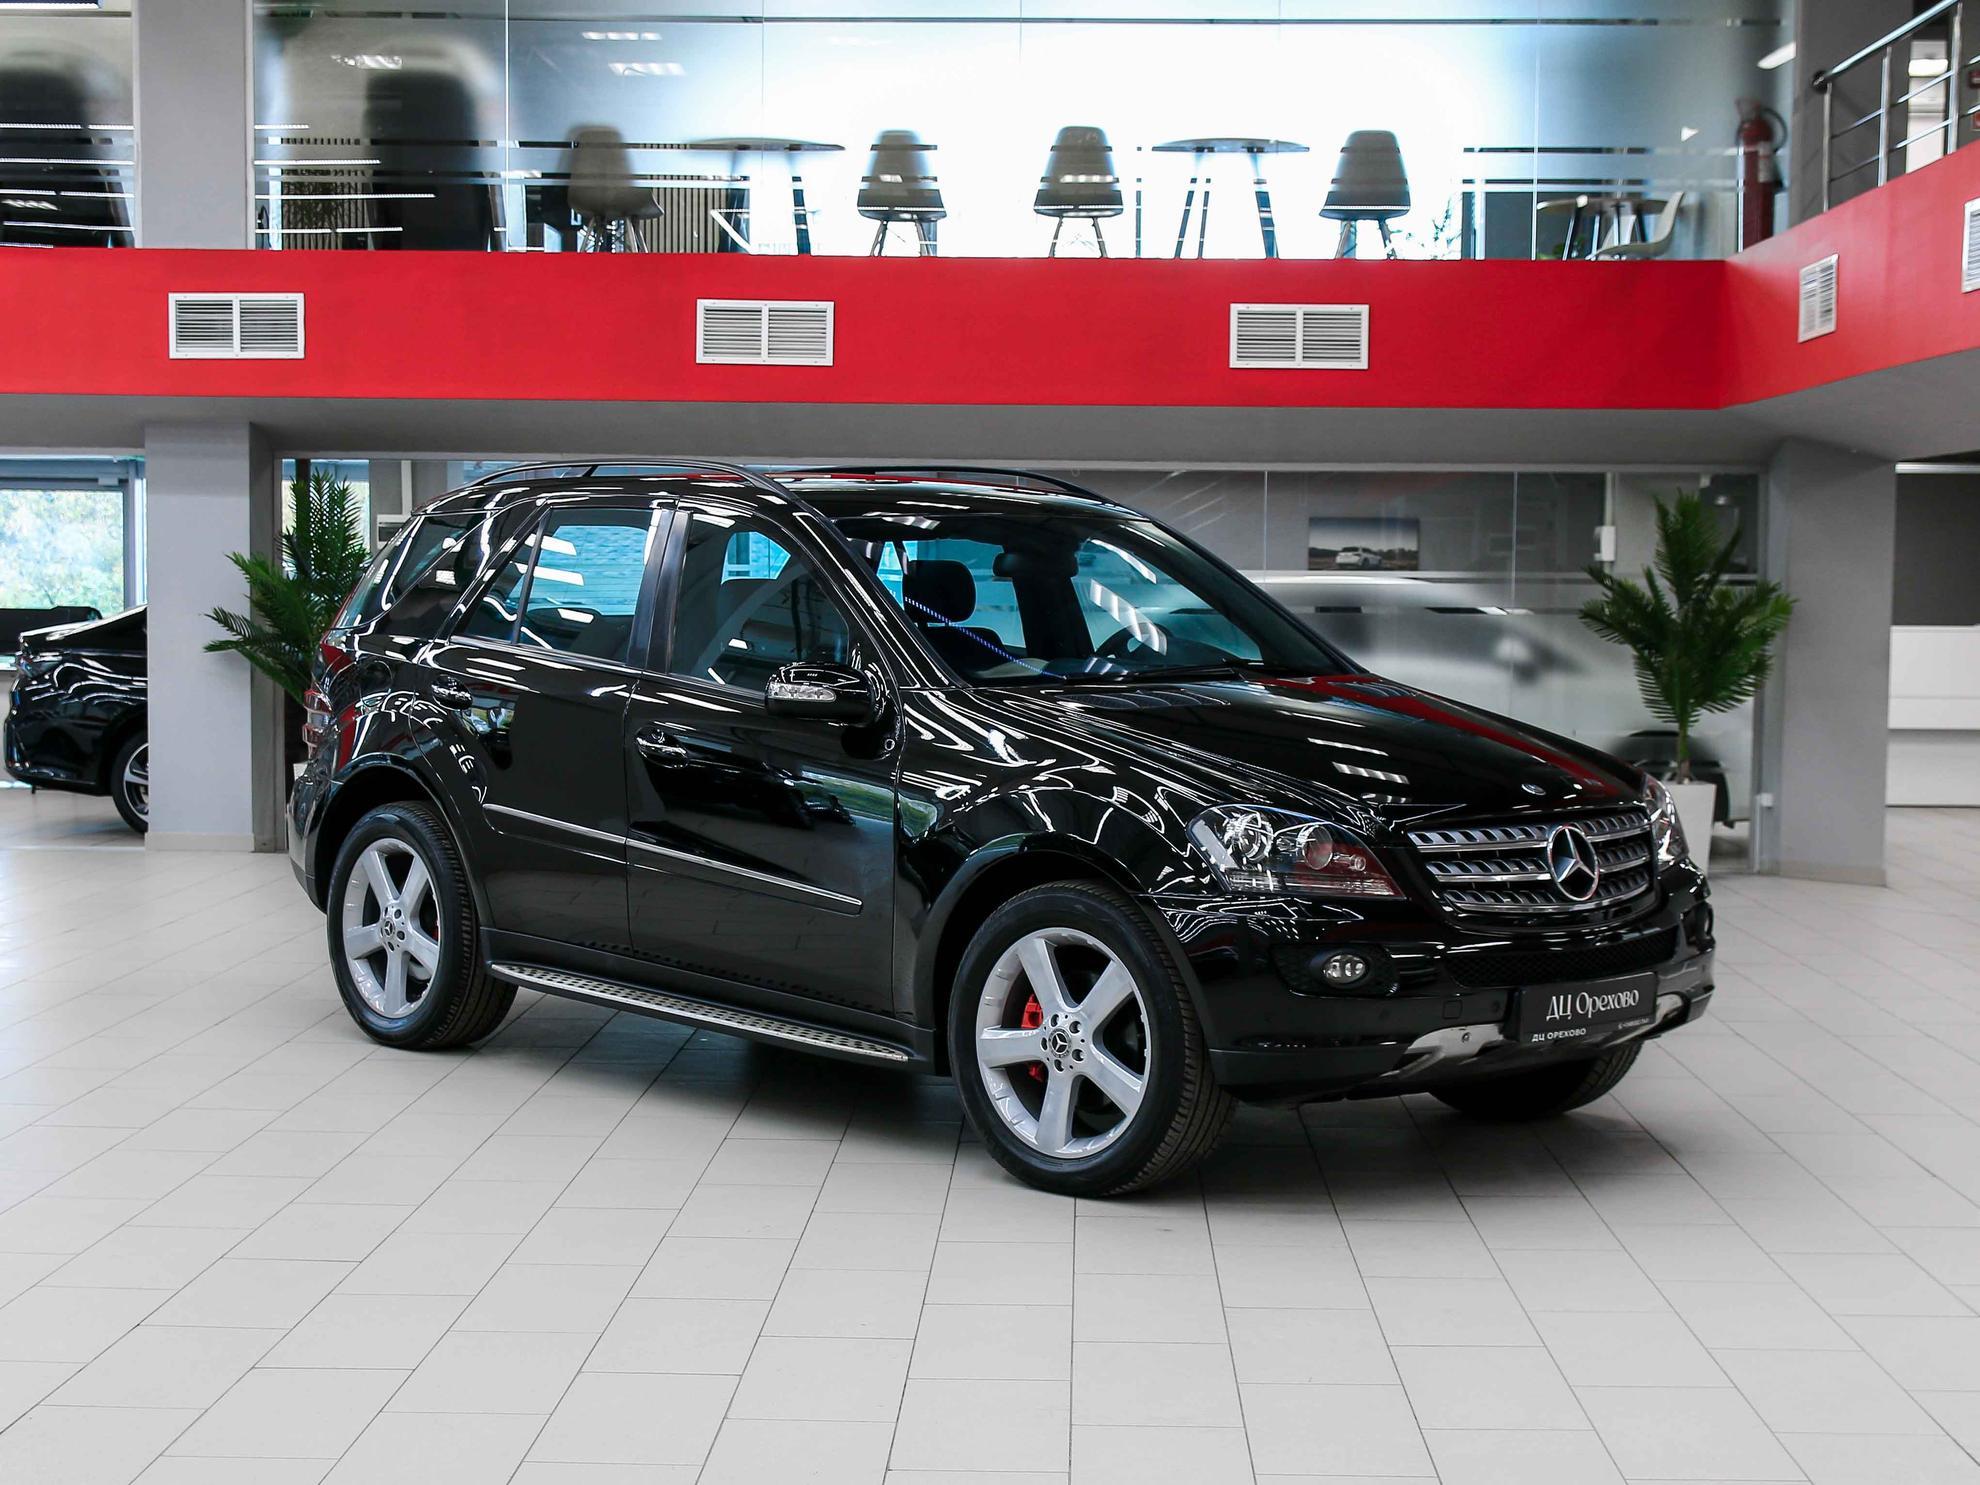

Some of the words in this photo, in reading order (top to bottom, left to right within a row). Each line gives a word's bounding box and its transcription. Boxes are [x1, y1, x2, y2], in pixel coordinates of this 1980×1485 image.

[1546, 994, 1572, 1021] ДЦ
[1576, 989, 1639, 1018] Орехово
[1532, 1033, 1545, 1042] ДЦ
[1547, 1028, 1587, 1039] ОРЕХОВО
